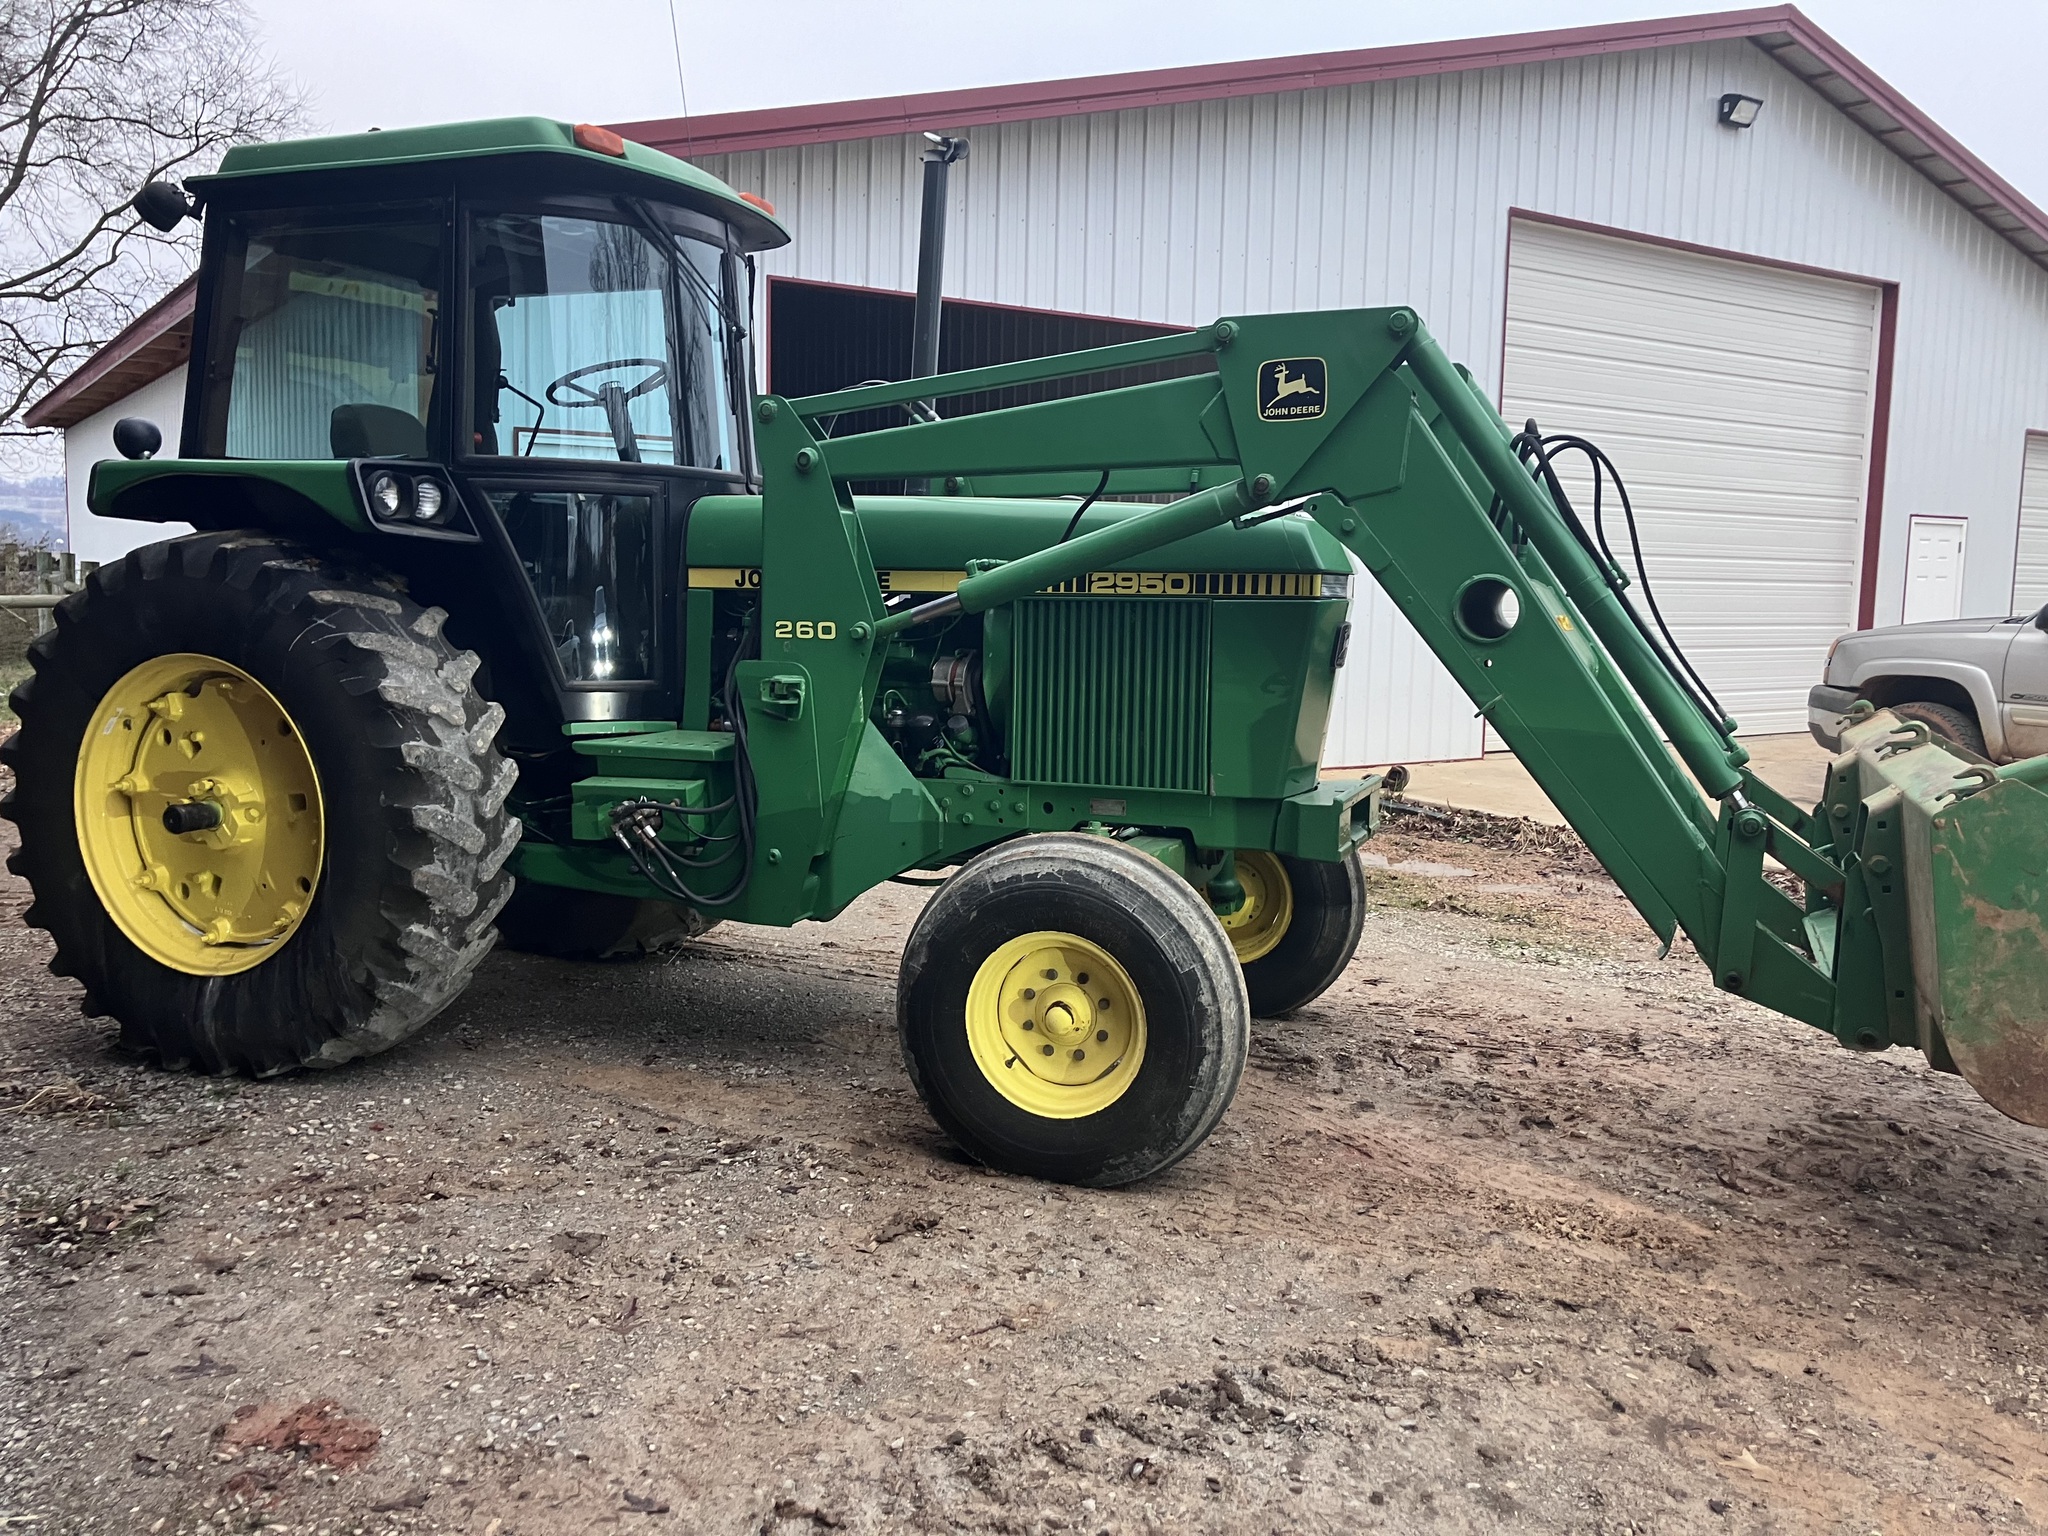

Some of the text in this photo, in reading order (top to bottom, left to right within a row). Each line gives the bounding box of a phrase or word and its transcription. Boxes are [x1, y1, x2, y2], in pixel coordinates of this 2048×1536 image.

[1263, 405, 1320, 417] JOHN DEERE
[735, 569, 763, 588] JO
[1091, 573, 1191, 594] 2950
[775, 620, 837, 640] 260
